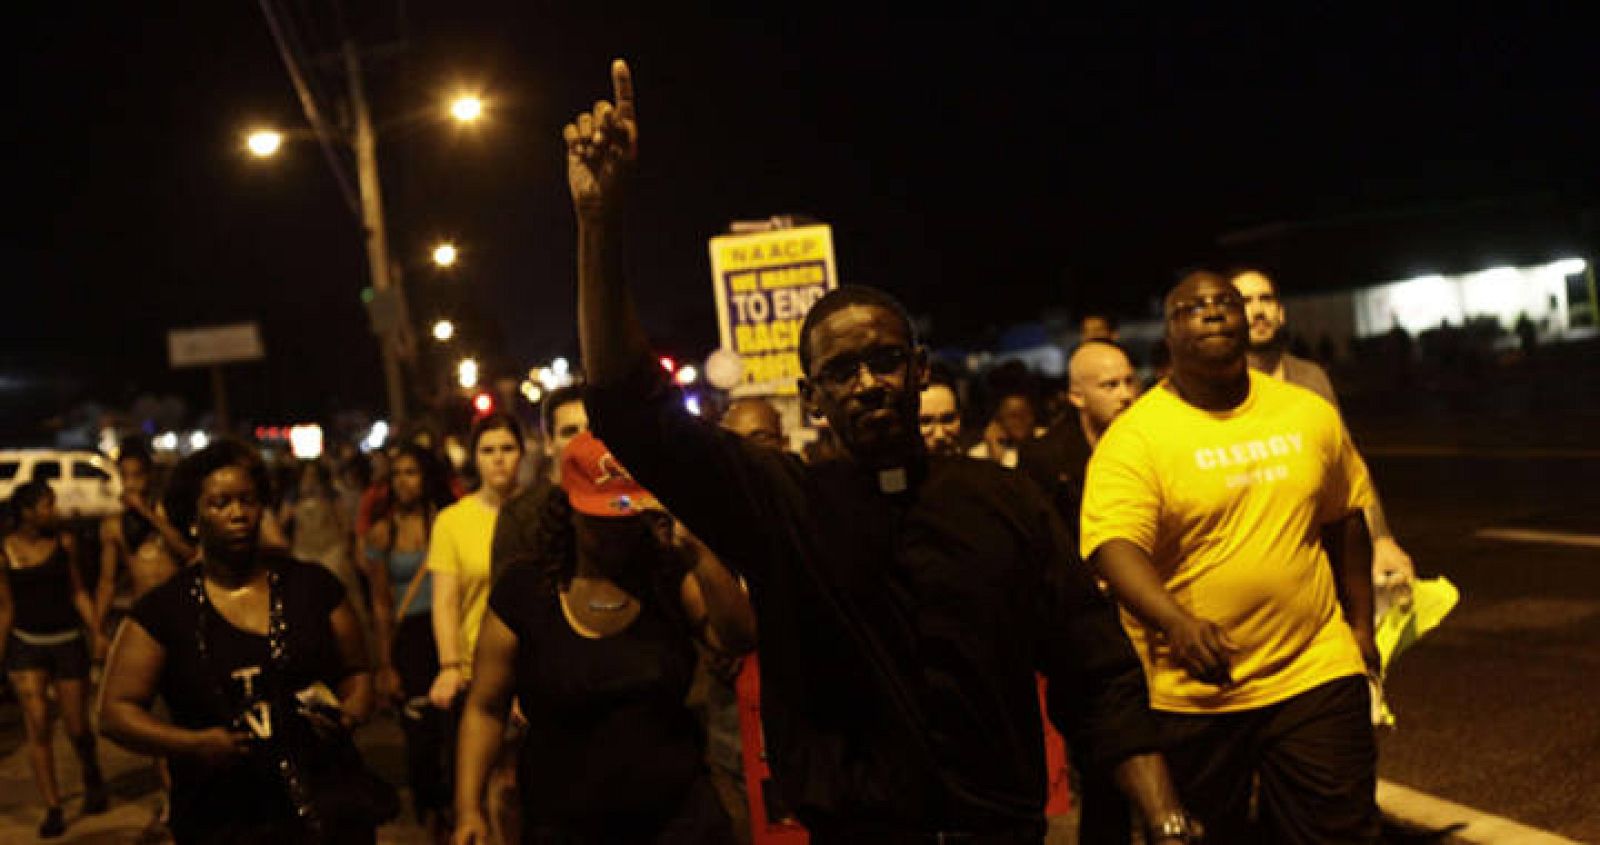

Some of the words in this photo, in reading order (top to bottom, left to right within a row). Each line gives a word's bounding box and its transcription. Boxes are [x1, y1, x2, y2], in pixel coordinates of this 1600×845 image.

[731, 239, 817, 262] NAACP
[731, 292, 770, 323] TO
[1195, 432, 1303, 470] CLERGY
